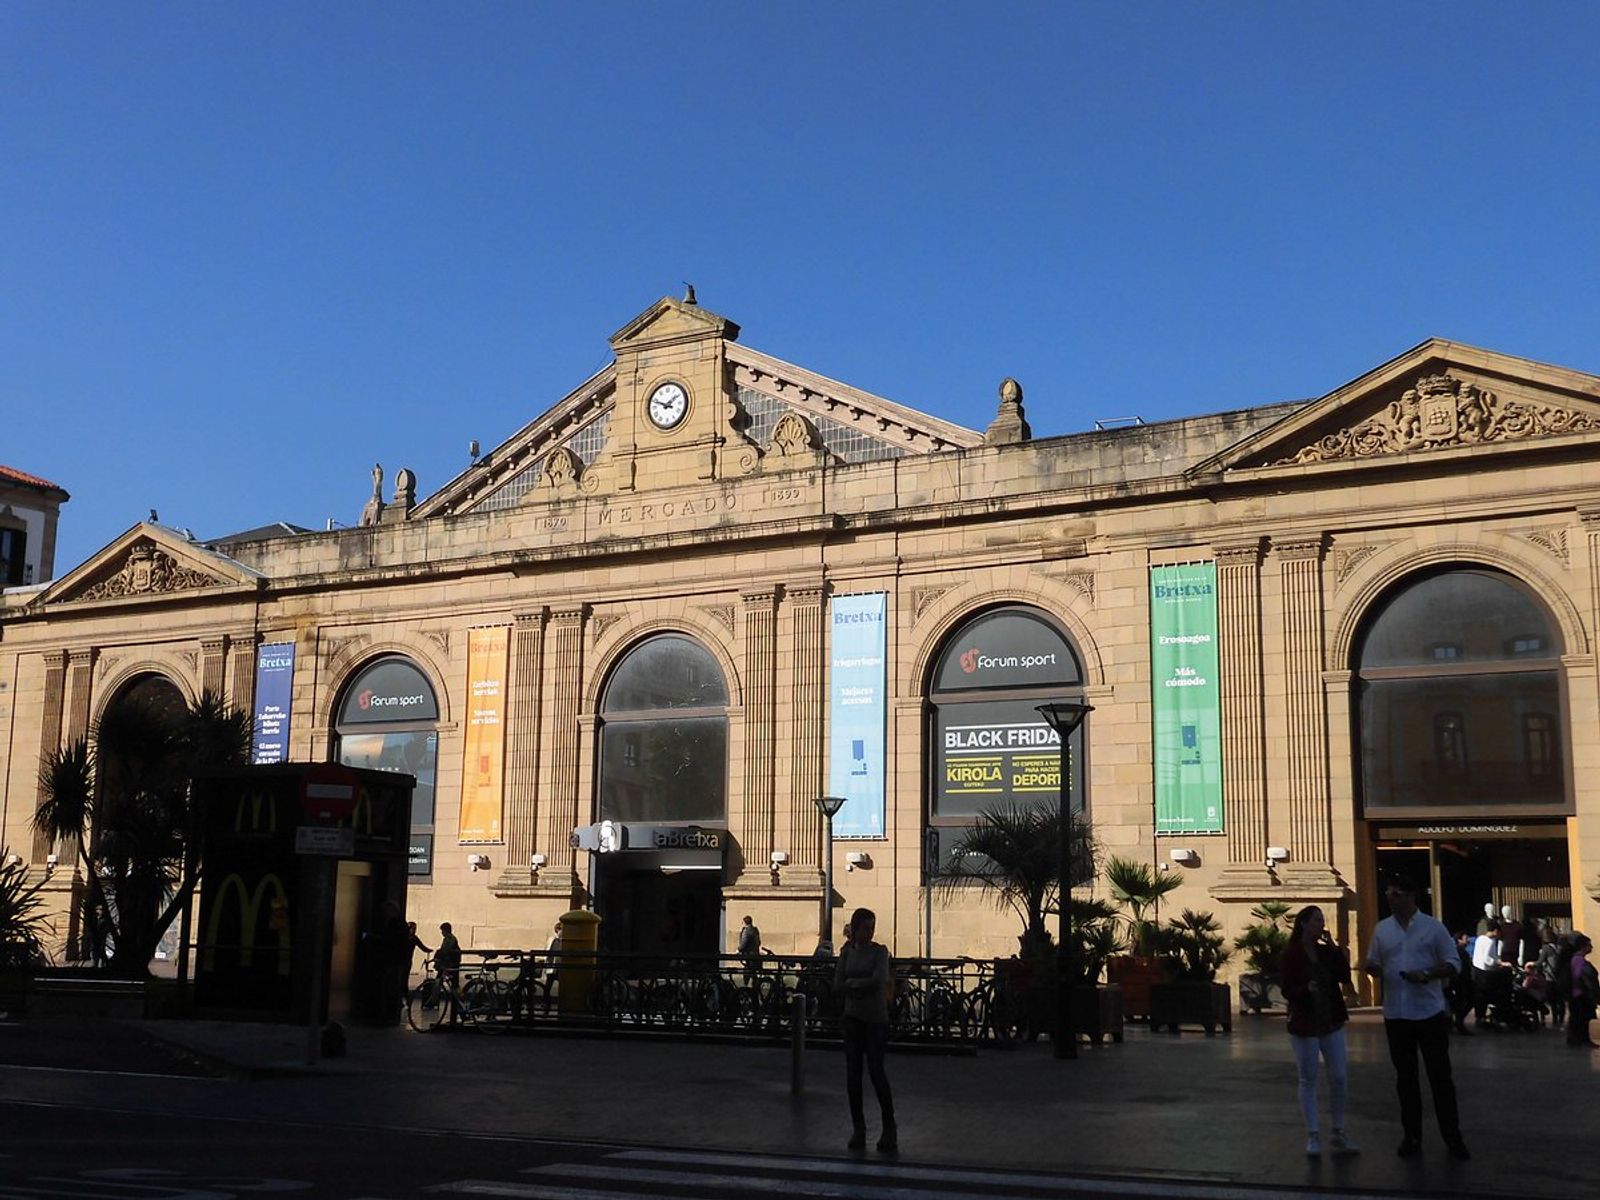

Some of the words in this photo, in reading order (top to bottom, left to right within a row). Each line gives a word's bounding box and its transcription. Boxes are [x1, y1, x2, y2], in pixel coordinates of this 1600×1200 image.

[773, 488, 800, 501] 1899
[598, 494, 737, 526] MERCADO
[1154, 583, 1212, 598] Bretxa
[834, 611, 882, 624] Bretxa
[259, 657, 291, 668] Bretxa
[1021, 653, 1056, 669] sport
[1165, 676, 1206, 687] cómodo
[399, 694, 424, 707] sport
[945, 730, 1003, 748] BLACK
[1008, 728, 1061, 745] FRIDA
[946, 767, 1003, 782] KIROLA
[1013, 773, 1061, 786] DEPORT
